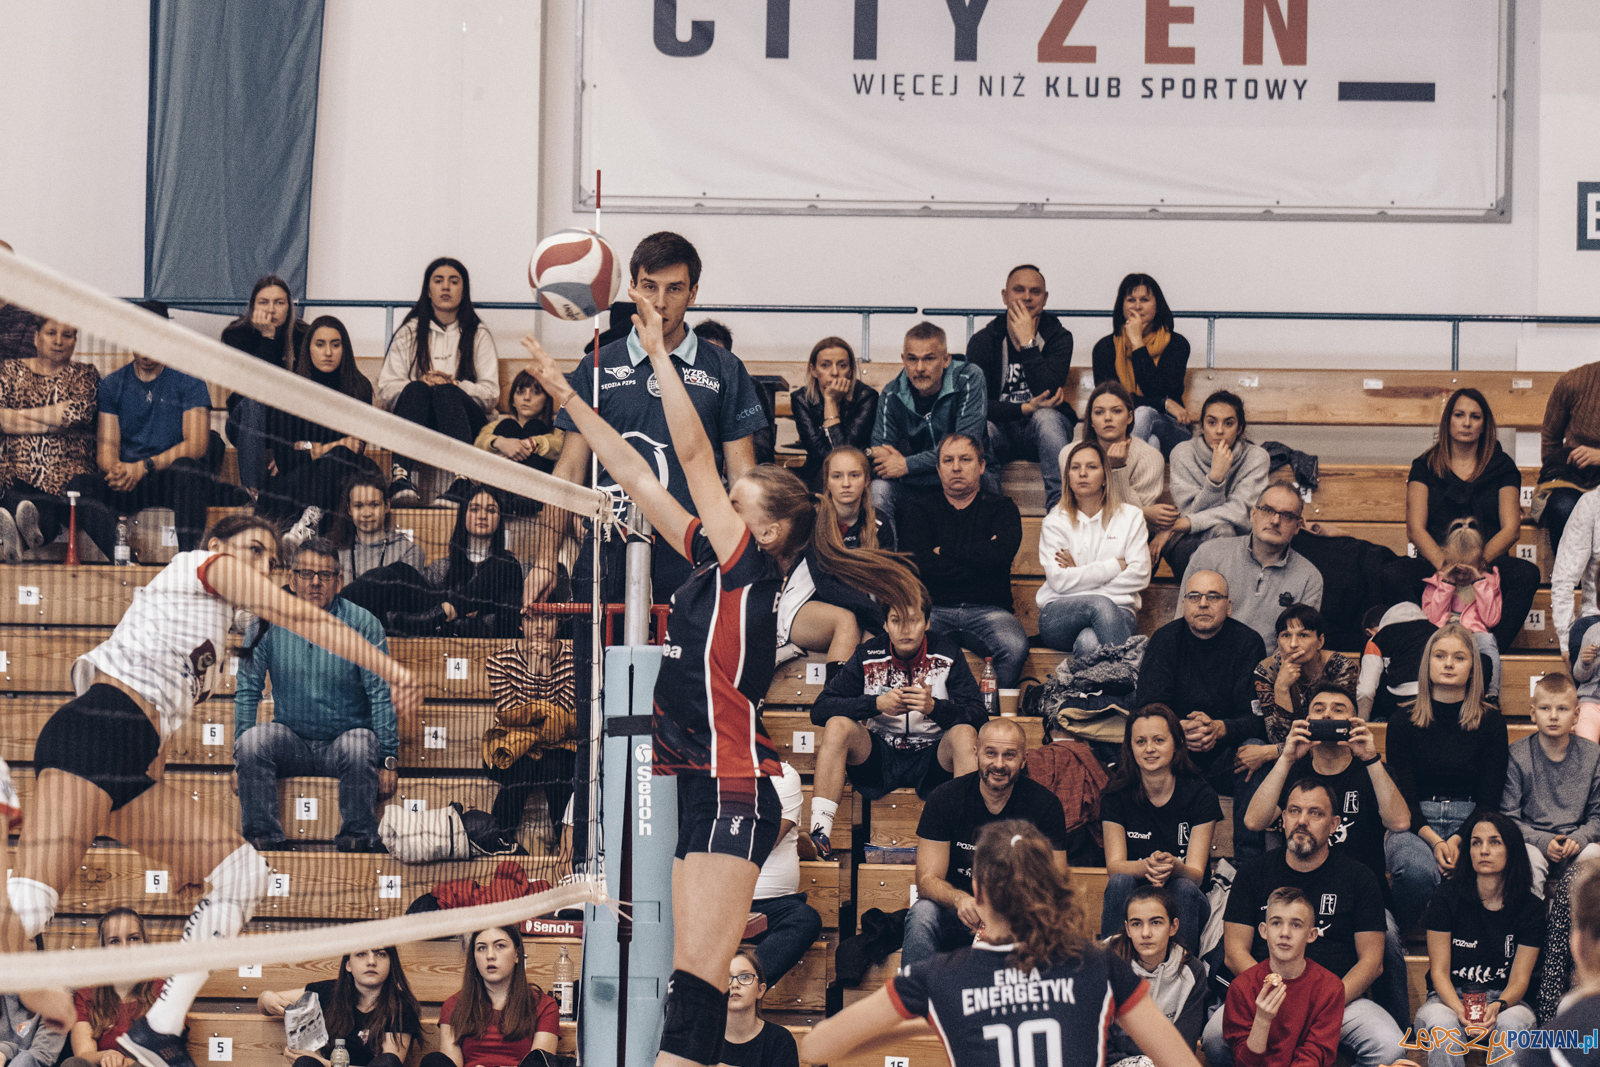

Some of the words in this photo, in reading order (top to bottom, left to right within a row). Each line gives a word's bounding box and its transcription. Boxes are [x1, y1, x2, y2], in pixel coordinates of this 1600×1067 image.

[853, 73, 958, 101] WIĘCEJ
[979, 73, 1025, 97] NIŻ
[1045, 76, 1121, 98] KLUB
[1141, 78, 1308, 100] SPORTOWY
[682, 367, 707, 378] WZPS
[1521, 548, 1532, 558] 11
[1529, 613, 1541, 623] 11
[454, 661, 460, 671] 4
[813, 667, 819, 677] 1
[210, 727, 216, 737] 6
[432, 730, 438, 740] 4
[800, 735, 806, 745] 1
[636, 765, 652, 836] Senoh
[304, 802, 310, 812] 5
[411, 803, 418, 813] 4
[154, 874, 160, 885] 6
[275, 878, 282, 889] 5
[387, 879, 394, 890] 4
[533, 920, 575, 934] Senoh
[962, 978, 1075, 1016] ENERGETYK
[217, 1041, 224, 1052] 5
[982, 1018, 1063, 1067] 10
